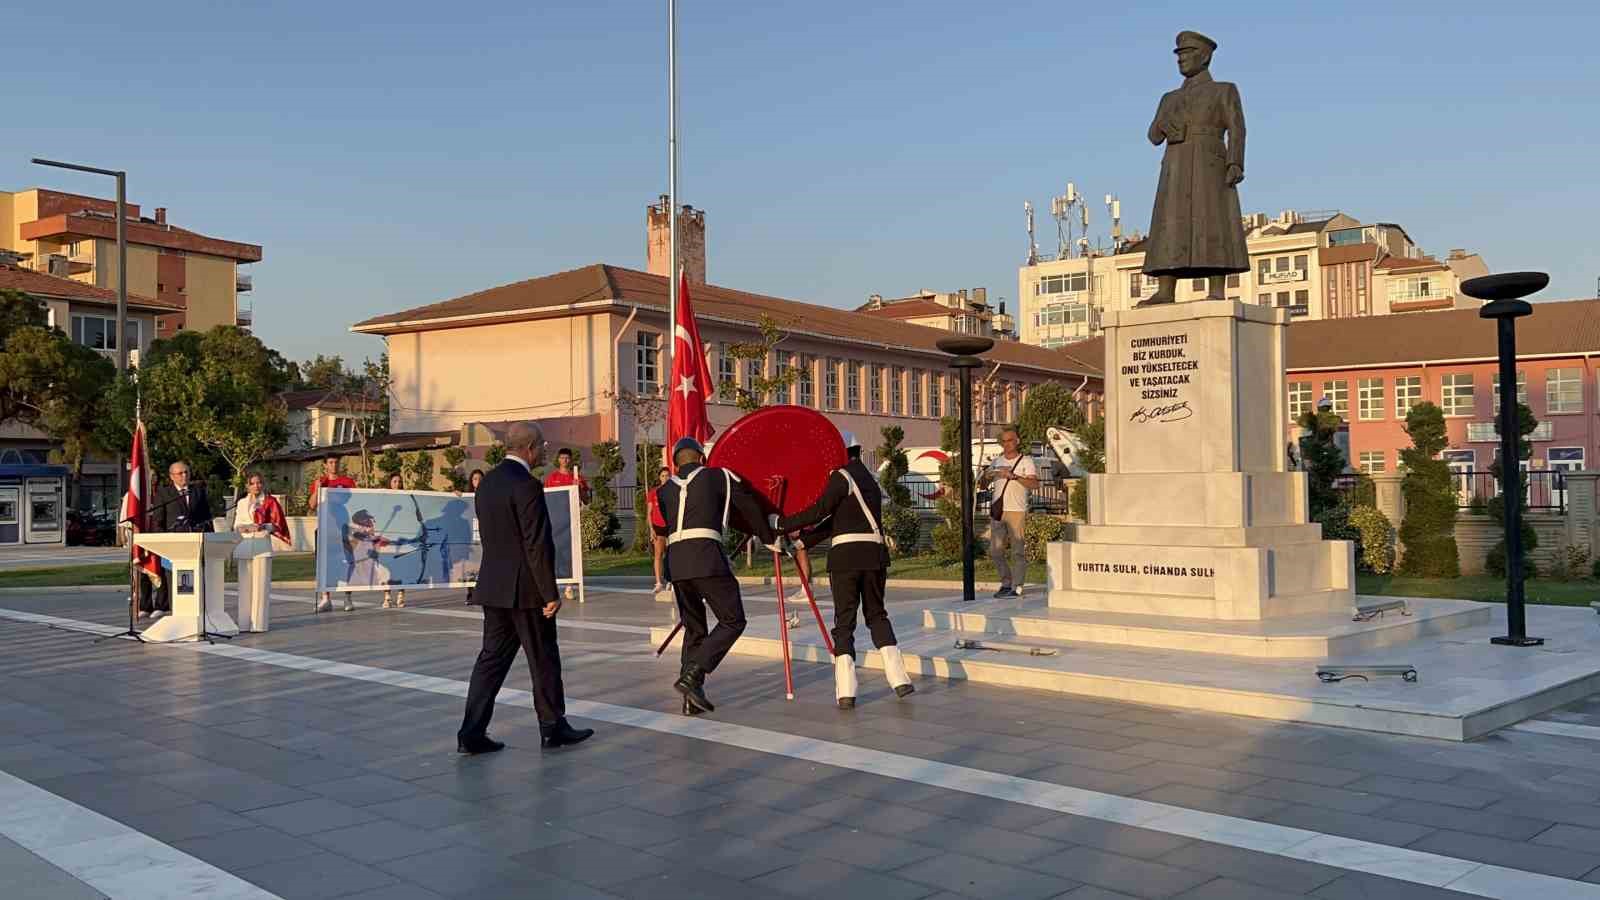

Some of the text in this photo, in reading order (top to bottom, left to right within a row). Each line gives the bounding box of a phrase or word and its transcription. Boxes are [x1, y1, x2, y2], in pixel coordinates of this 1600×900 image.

[1131, 334, 1188, 348] CUMHURİYETİ
[1133, 351, 1146, 361] BİZ
[1121, 360, 1199, 375] ONU YÜKSELTECEK
[1130, 374, 1191, 387] VE YAŞATACAK
[1142, 388, 1179, 399] SİZSİNİZ
[1077, 562, 1110, 573] YURTTA
[1143, 563, 1187, 577] CİHANDA
